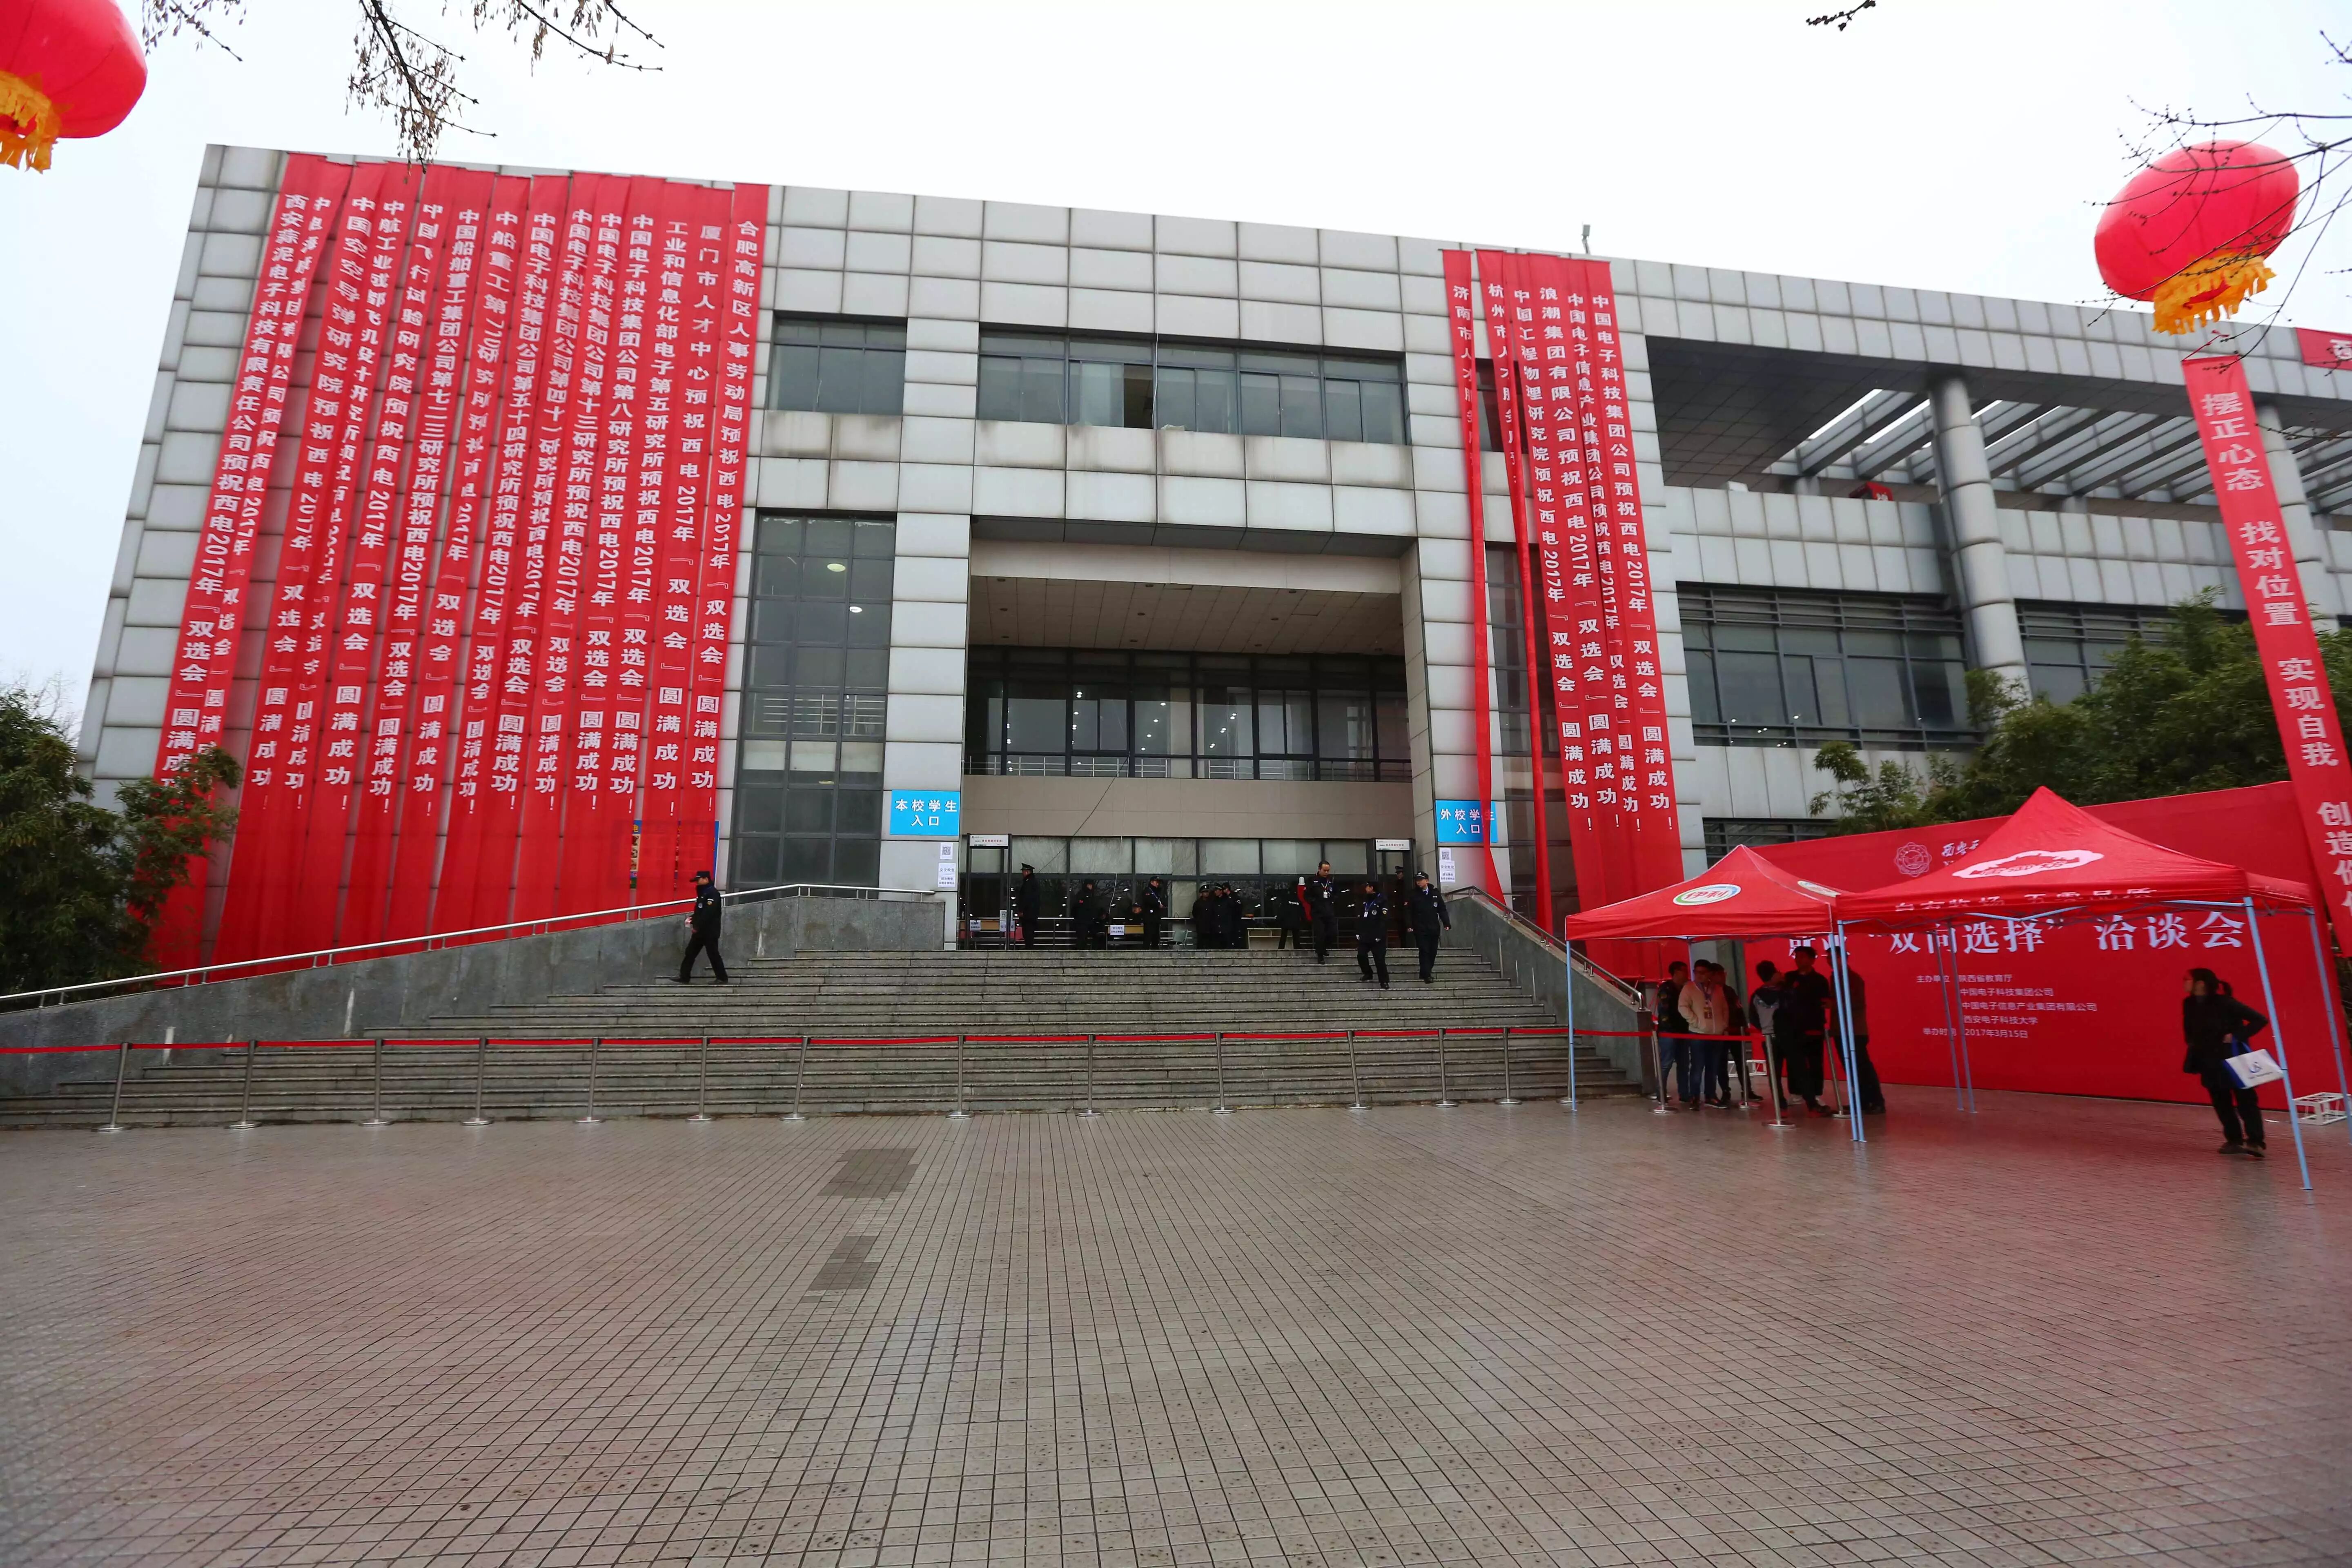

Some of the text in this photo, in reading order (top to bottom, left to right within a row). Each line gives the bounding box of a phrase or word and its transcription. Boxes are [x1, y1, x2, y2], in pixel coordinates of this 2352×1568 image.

[2201, 392, 2352, 917] 摆正心态 找对位置 实现自我 创造价
[895, 799, 958, 812] 本校学生
[911, 815, 939, 826] 入口
[1456, 823, 1481, 834] 入口
[2093, 911, 2245, 950] 洽谈会
[1960, 988, 2054, 996] 中国电子科技集团公司
[1964, 1015, 2038, 1025] 西安电子科技大学
